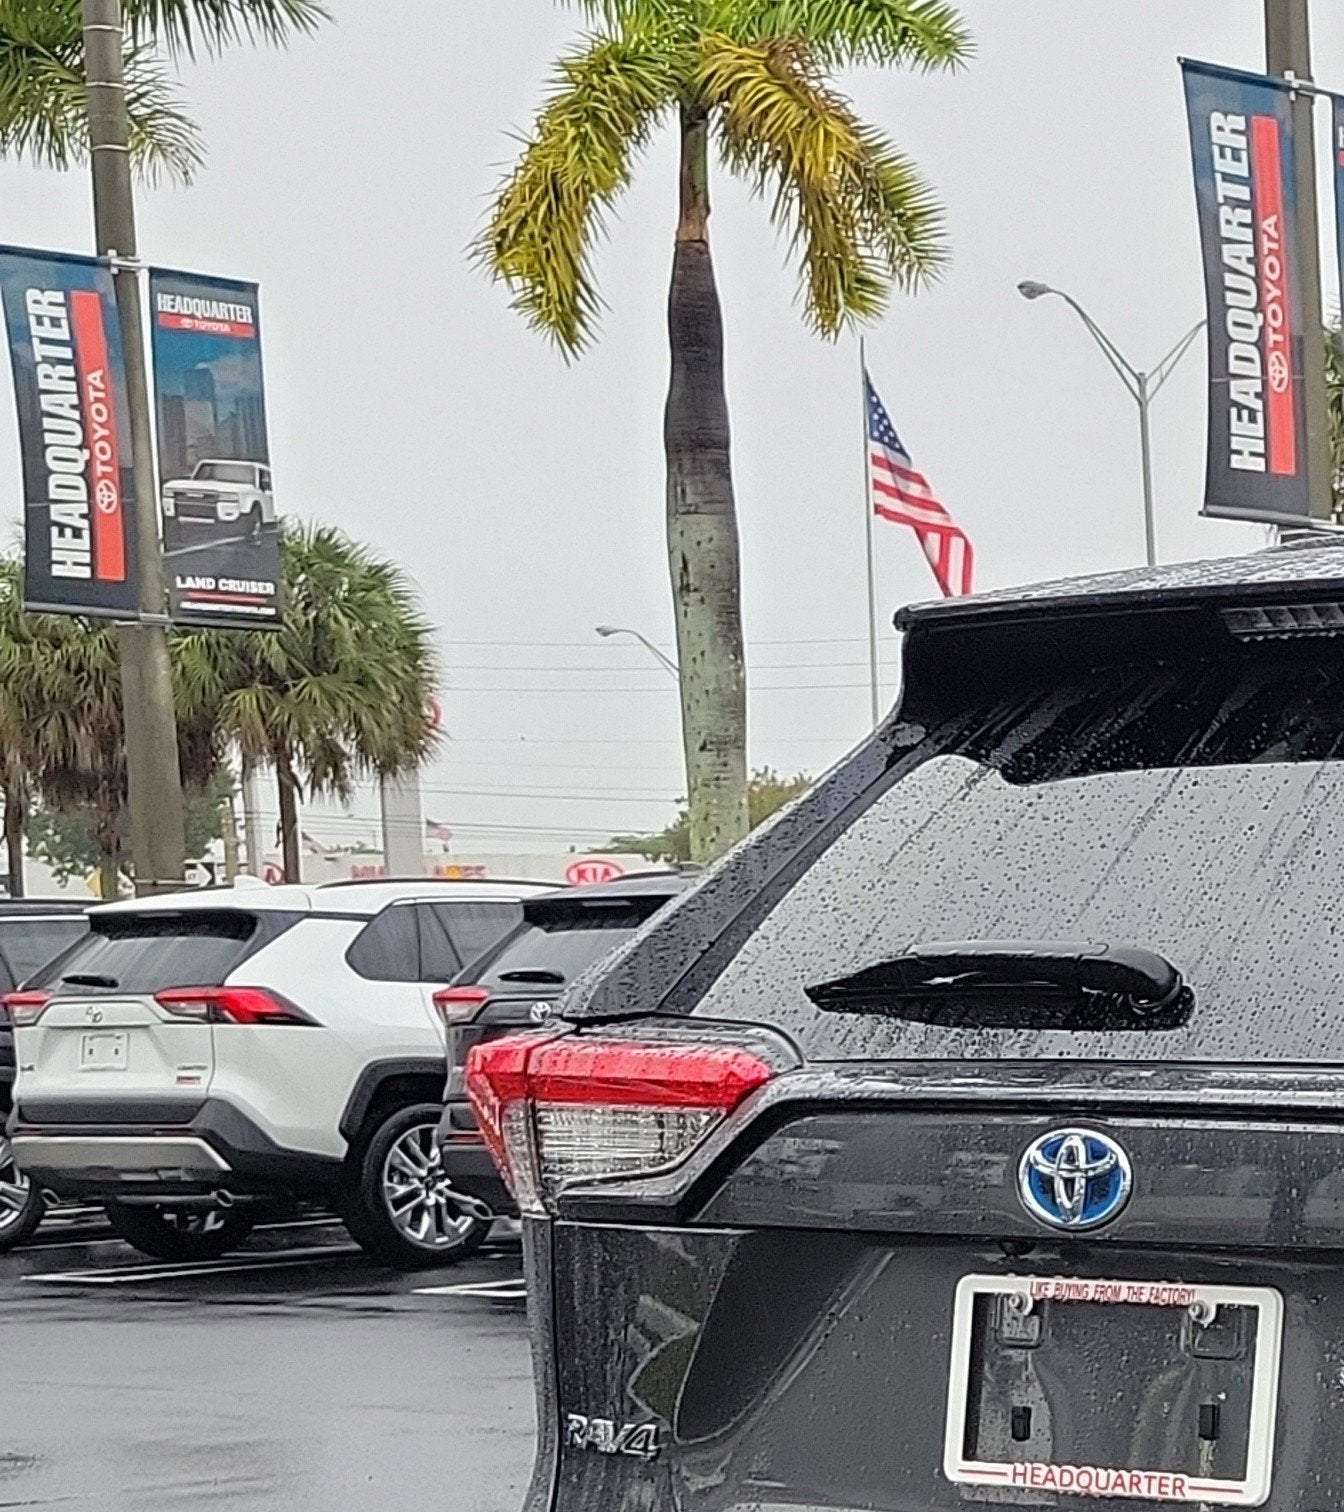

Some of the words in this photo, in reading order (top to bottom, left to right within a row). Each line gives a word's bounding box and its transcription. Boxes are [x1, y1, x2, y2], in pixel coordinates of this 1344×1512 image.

[1210, 111, 1266, 473] HEADQUARTER
[1262, 214, 1285, 348] TOYOTA
[157, 293, 253, 324] HEADQUARTER
[25, 288, 92, 579] HEADQUARTER
[86, 368, 114, 477] TOYOTA
[176, 576, 216, 590] LAND
[218, 578, 275, 595] CRUISER
[576, 867, 612, 883] KIA
[1030, 1281, 1051, 1298] LIKE
[1053, 1282, 1089, 1300] BUYING
[1093, 1284, 1122, 1302] FROM
[1127, 1286, 1145, 1302] THE
[1149, 1288, 1196, 1305] FACTORY!
[565, 1412, 660, 1461] RAV4
[1012, 1465, 1186, 1497] HEADQUARTER
